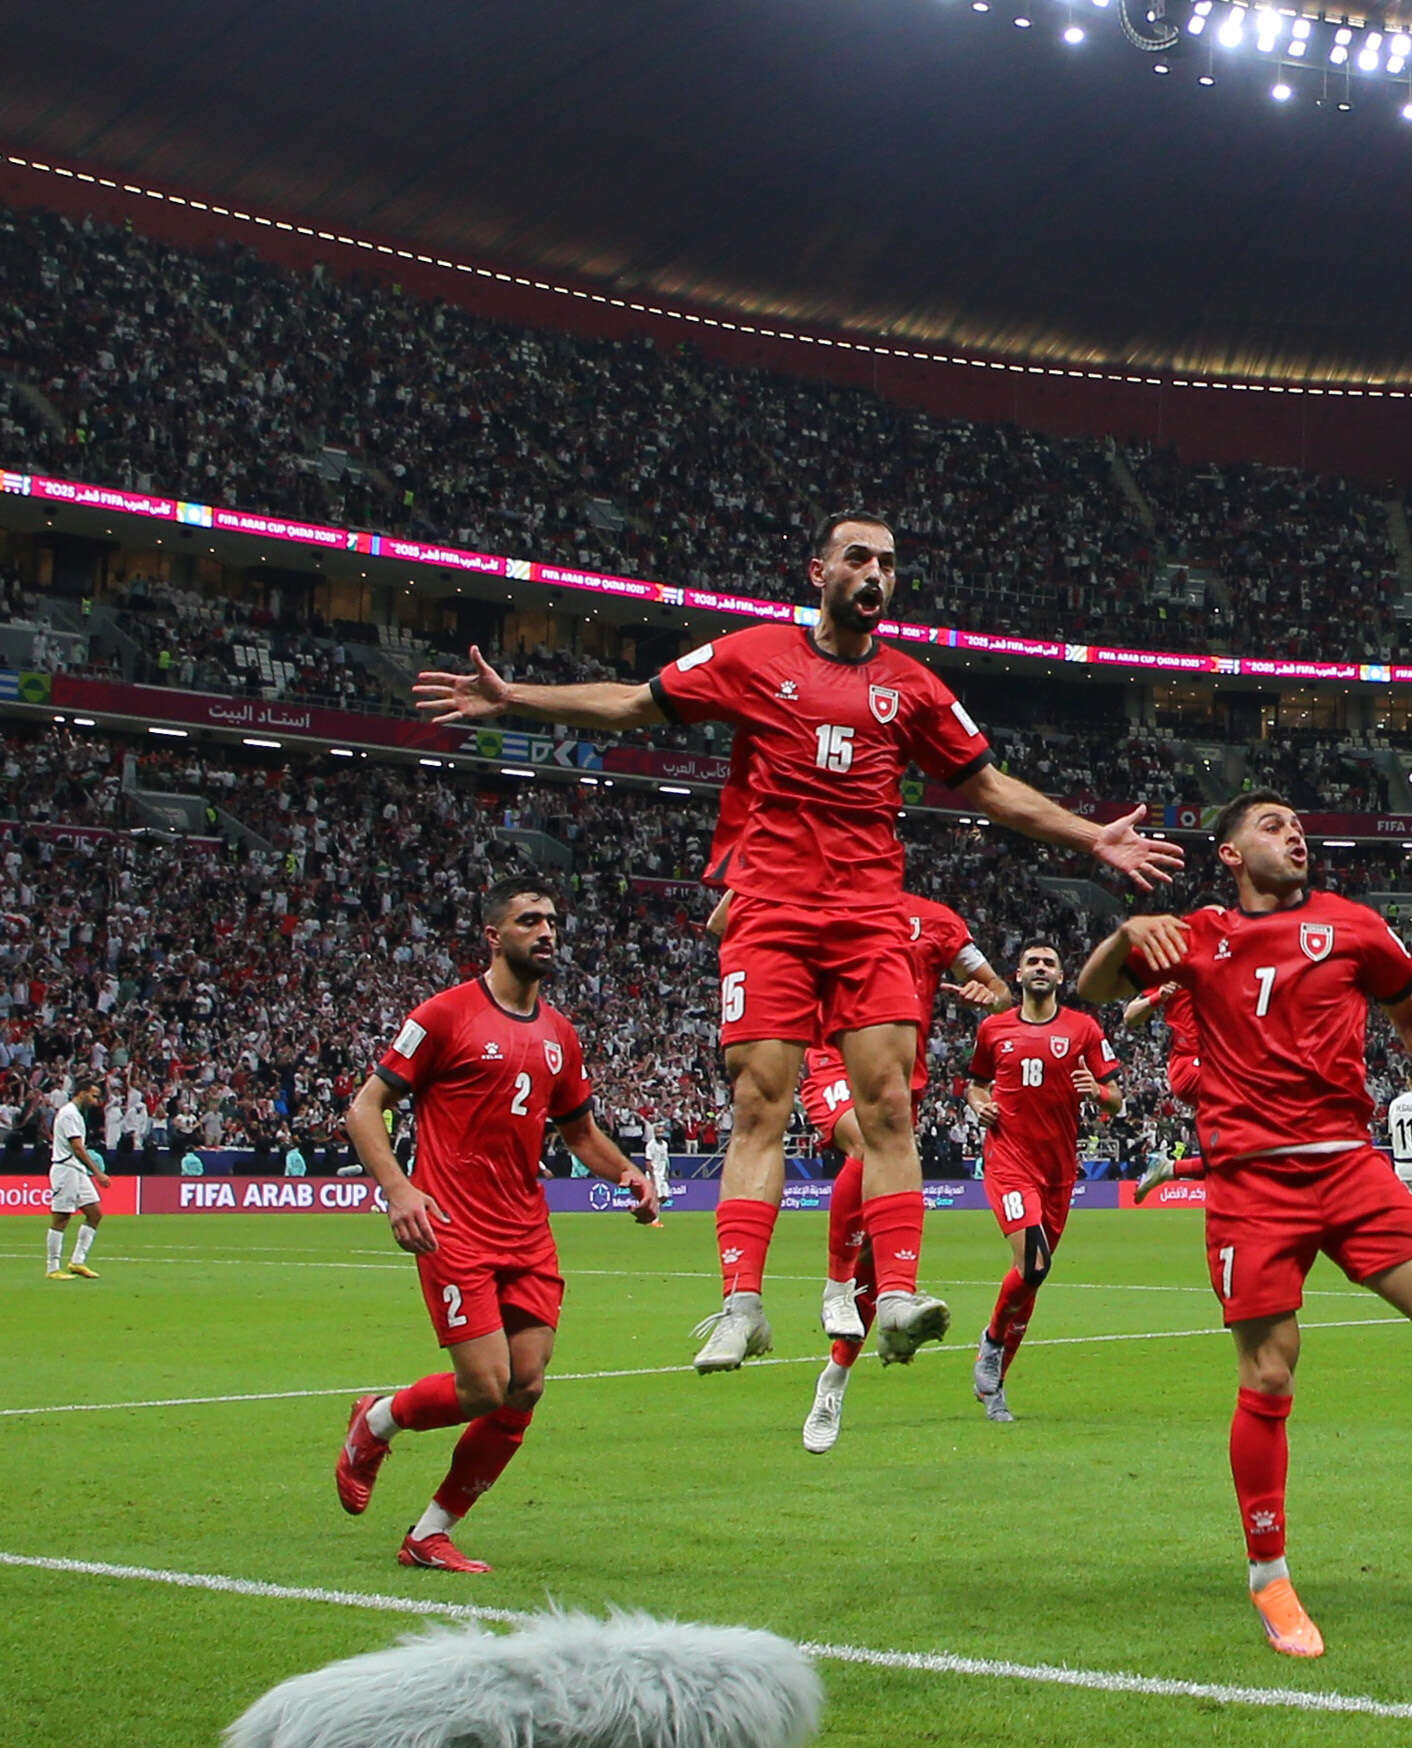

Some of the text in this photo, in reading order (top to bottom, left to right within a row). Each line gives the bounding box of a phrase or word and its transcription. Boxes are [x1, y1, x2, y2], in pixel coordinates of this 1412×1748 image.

[218, 514, 238, 526] FIFA
[241, 518, 266, 531] ARAB
[267, 522, 286, 533] CUP
[542, 569, 560, 580] FIFA
[561, 572, 583, 584] ARAB
[585, 576, 600, 586] CUP
[1098, 652, 1116, 660] FIFA
[1117, 653, 1139, 662] ARAB
[1140, 655, 1156, 664] CUP
[208, 704, 310, 728] استاد البيت
[815, 724, 854, 772] 15
[1377, 820, 1406, 832] FIFA
[1256, 967, 1276, 1016] 7
[1020, 1058, 1043, 1086] 18
[511, 1072, 530, 1116] 2
[822, 1080, 850, 1111] 14
[181, 1183, 232, 1208] FIFA
[244, 1184, 312, 1208] ARAB
[320, 1184, 366, 1208] CUP
[785, 1198, 799, 1208] City
[1002, 1191, 1024, 1222] 18
[444, 1285, 468, 1328] 2
